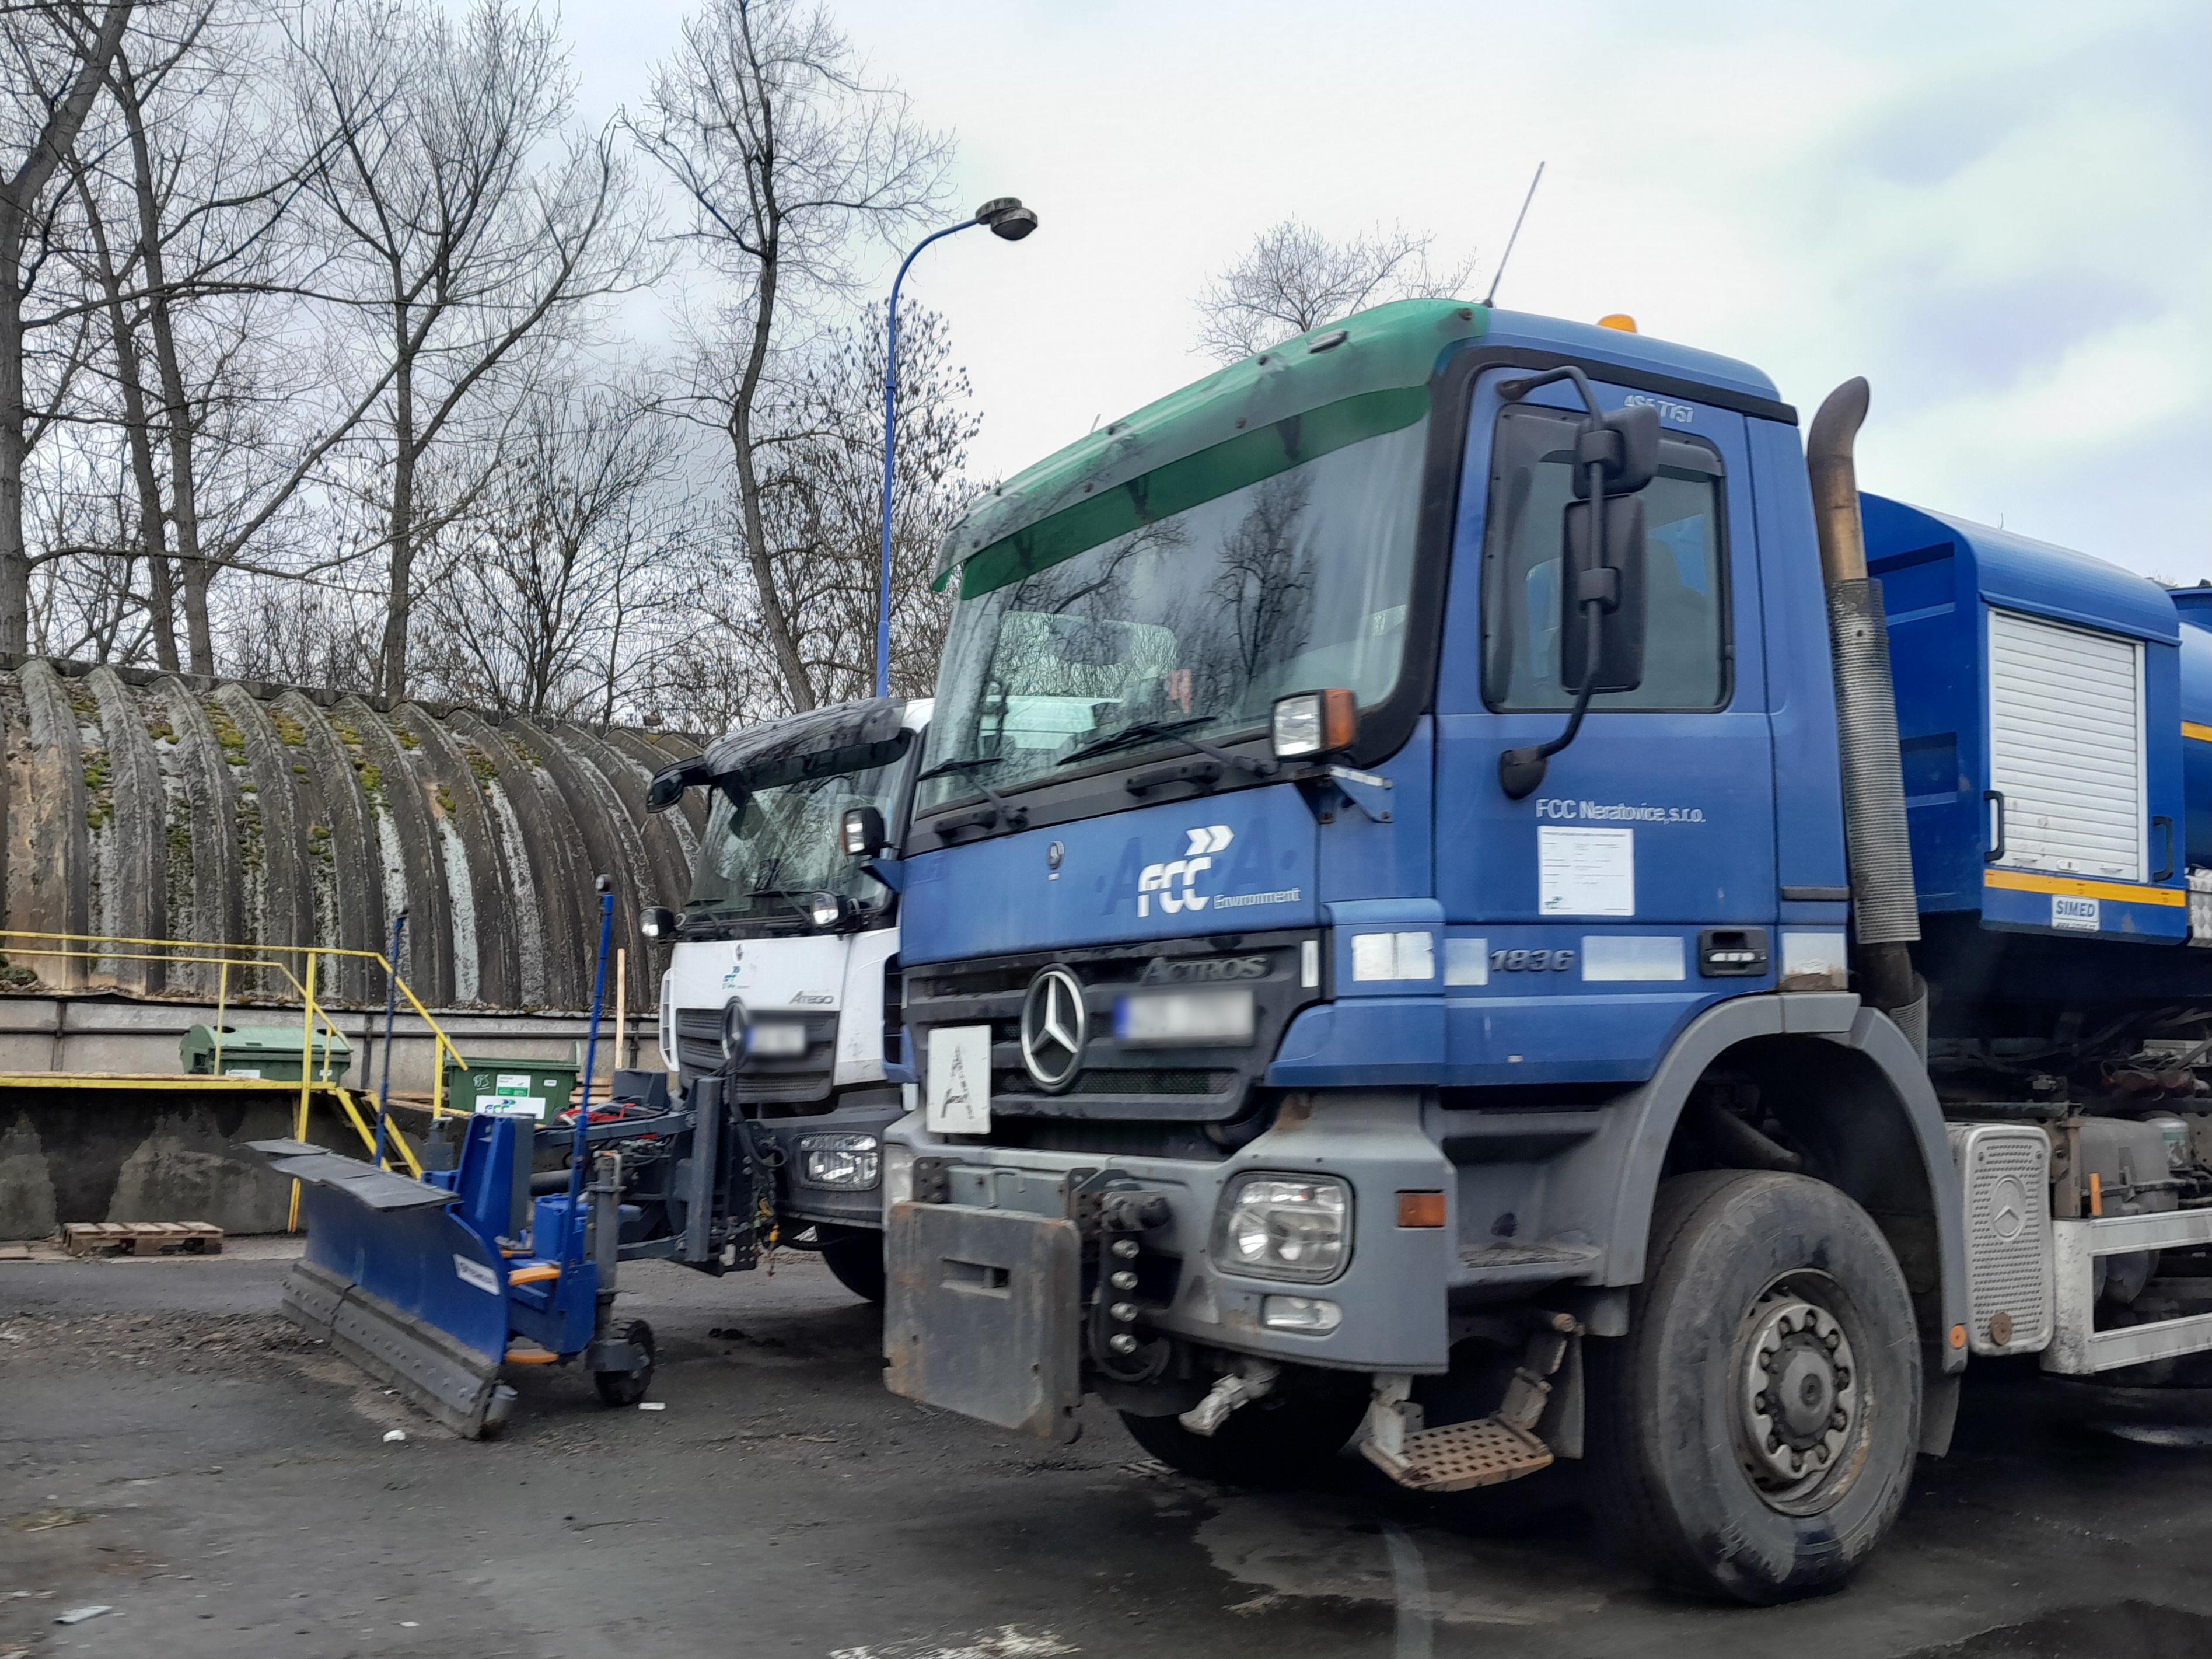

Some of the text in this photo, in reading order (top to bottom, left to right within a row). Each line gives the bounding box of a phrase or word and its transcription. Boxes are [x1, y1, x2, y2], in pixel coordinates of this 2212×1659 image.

[1536, 799, 1577, 818] FCC
[1137, 857, 1211, 918] FCC
[1214, 887, 1301, 909] Environment
[2056, 900, 2095, 917] SIMED
[1490, 949, 1574, 972] 1836
[788, 990, 834, 1004] ATEGO
[941, 1044, 975, 1120] A
